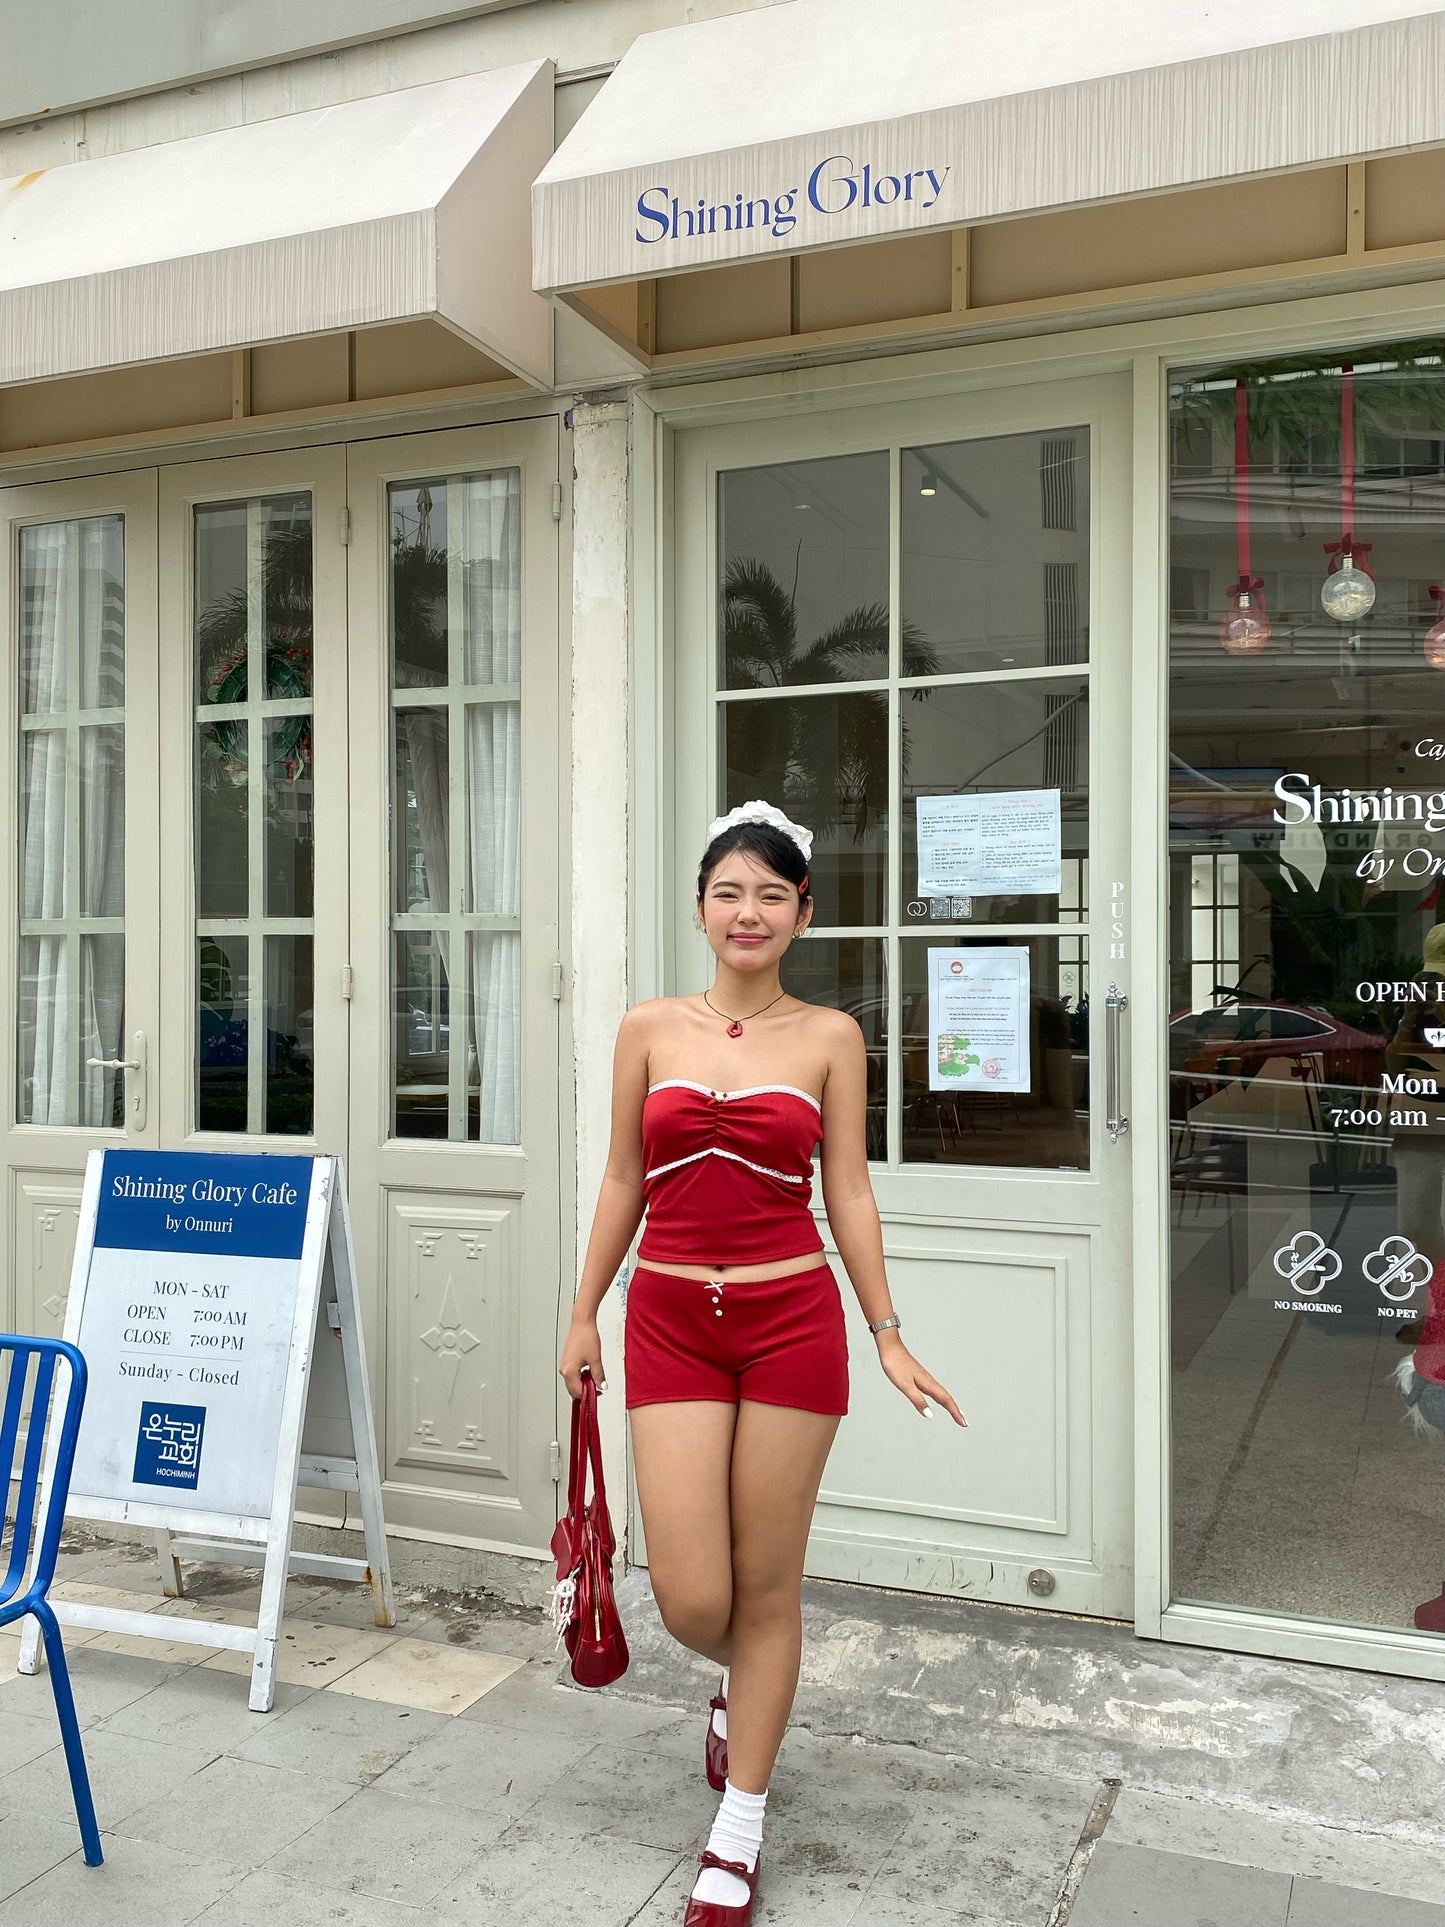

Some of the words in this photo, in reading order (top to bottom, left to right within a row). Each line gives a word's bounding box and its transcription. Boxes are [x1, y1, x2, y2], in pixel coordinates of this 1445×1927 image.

[635, 187, 798, 244] Shining
[807, 155, 952, 214] Glory
[1356, 849, 1395, 884] by
[1109, 881, 1126, 960] PUSH
[1355, 981, 1429, 1003] OPEN
[1380, 1073, 1439, 1095] Mon
[1331, 1109, 1382, 1128] 7:00
[1390, 1109, 1429, 1126] am
[112, 1175, 187, 1205] Shining
[192, 1178, 248, 1207] Glory
[252, 1181, 298, 1205] Cafe
[166, 1214, 182, 1233] by
[184, 1216, 233, 1233] Onnuri
[152, 1280, 189, 1296] MON
[201, 1283, 230, 1299] SAT
[127, 1304, 167, 1321] OPEN
[193, 1310, 222, 1323] 7:00
[223, 1311, 248, 1326] AM
[1274, 1300, 1291, 1310] NO
[1291, 1301, 1343, 1313] SMOKING
[1378, 1307, 1394, 1318] NO
[1396, 1308, 1418, 1319] PET
[123, 1328, 172, 1346] CLOSE
[189, 1334, 219, 1348] 7:00
[220, 1334, 245, 1350] PM
[118, 1361, 173, 1383] Sunday
[189, 1367, 240, 1386] Closed
[142, 1413, 201, 1445] 온누리
[158, 1440, 199, 1469] 교회
[156, 1467, 196, 1480] HOCHIMINH
